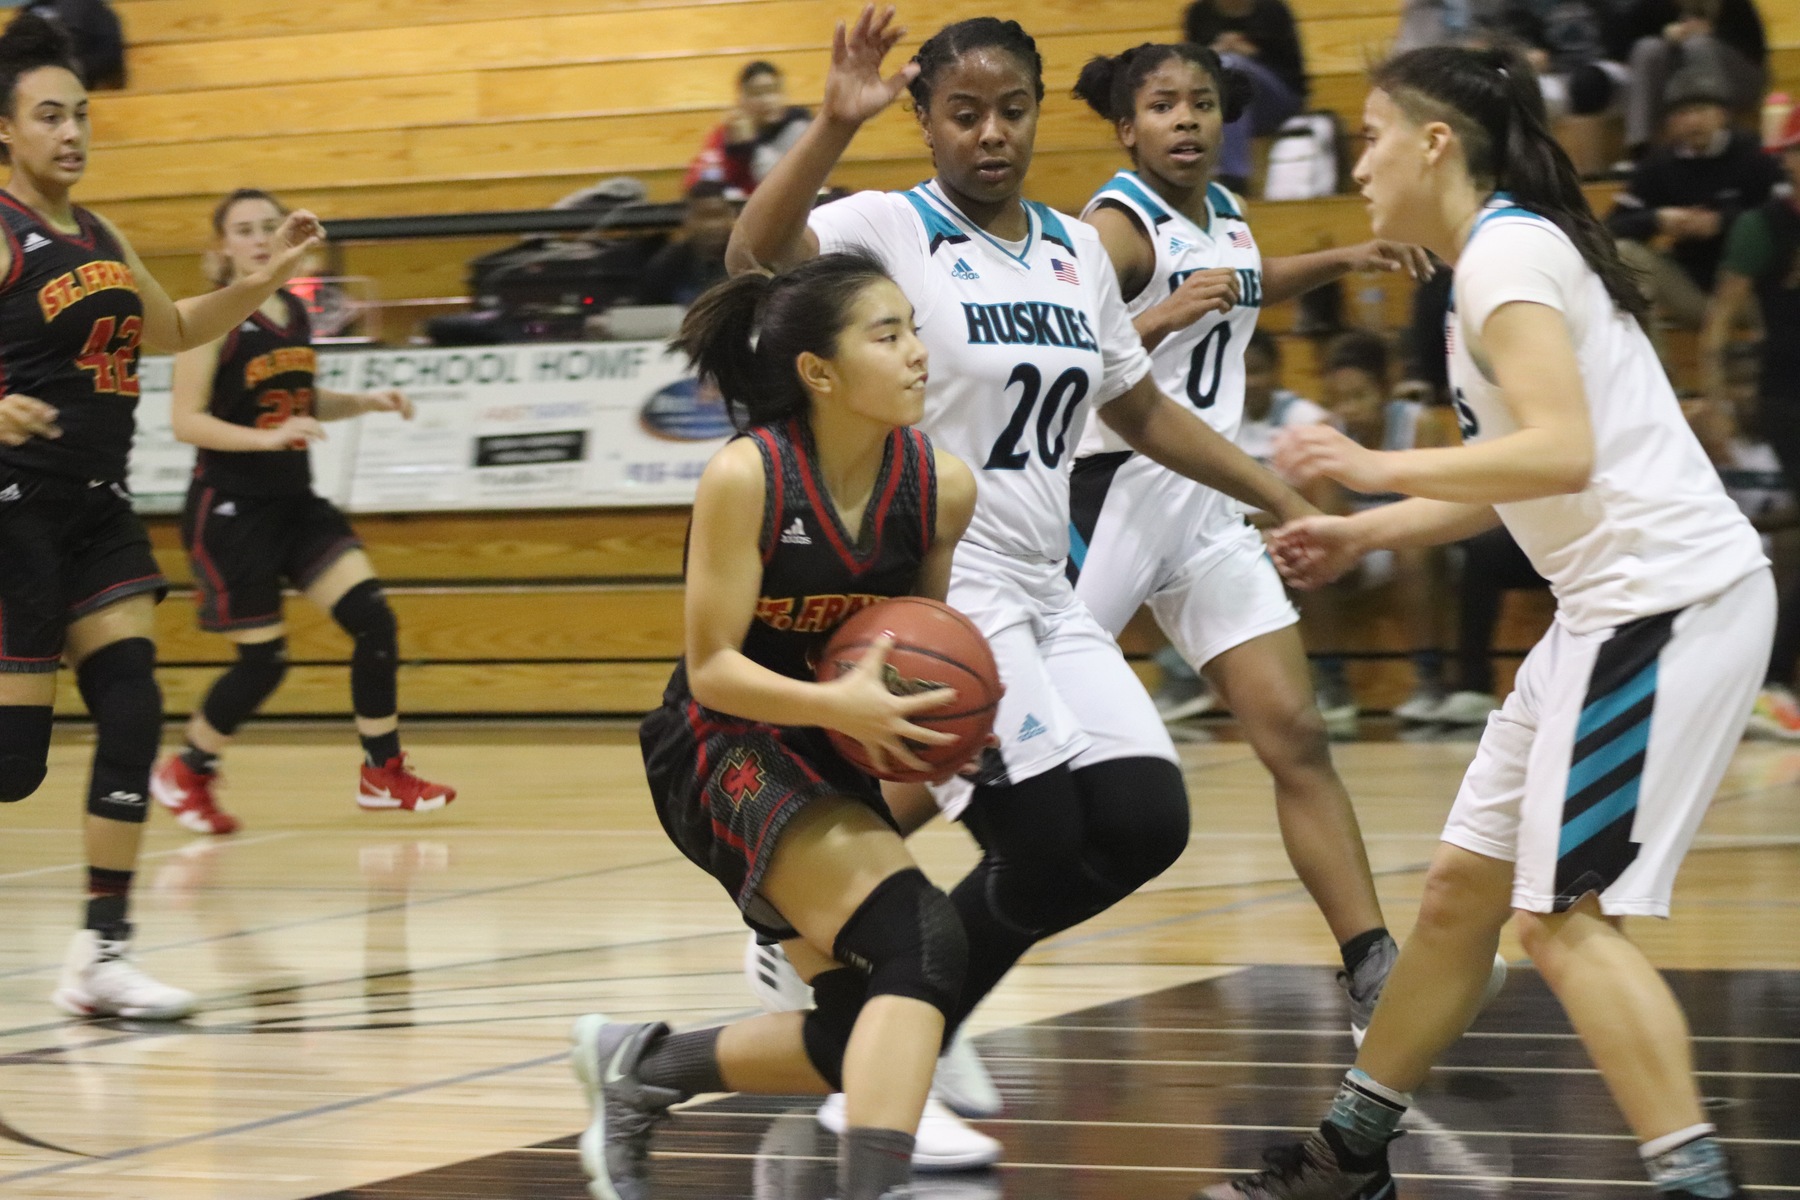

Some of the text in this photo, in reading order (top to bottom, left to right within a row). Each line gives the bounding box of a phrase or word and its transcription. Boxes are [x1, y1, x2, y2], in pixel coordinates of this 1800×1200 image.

[75, 315, 142, 397] 42
[960, 301, 1100, 354] HUSKIES
[362, 351, 519, 389] SCHOOL
[1186, 321, 1232, 410] 0
[983, 362, 1090, 471] 20
[793, 593, 890, 633] FR
